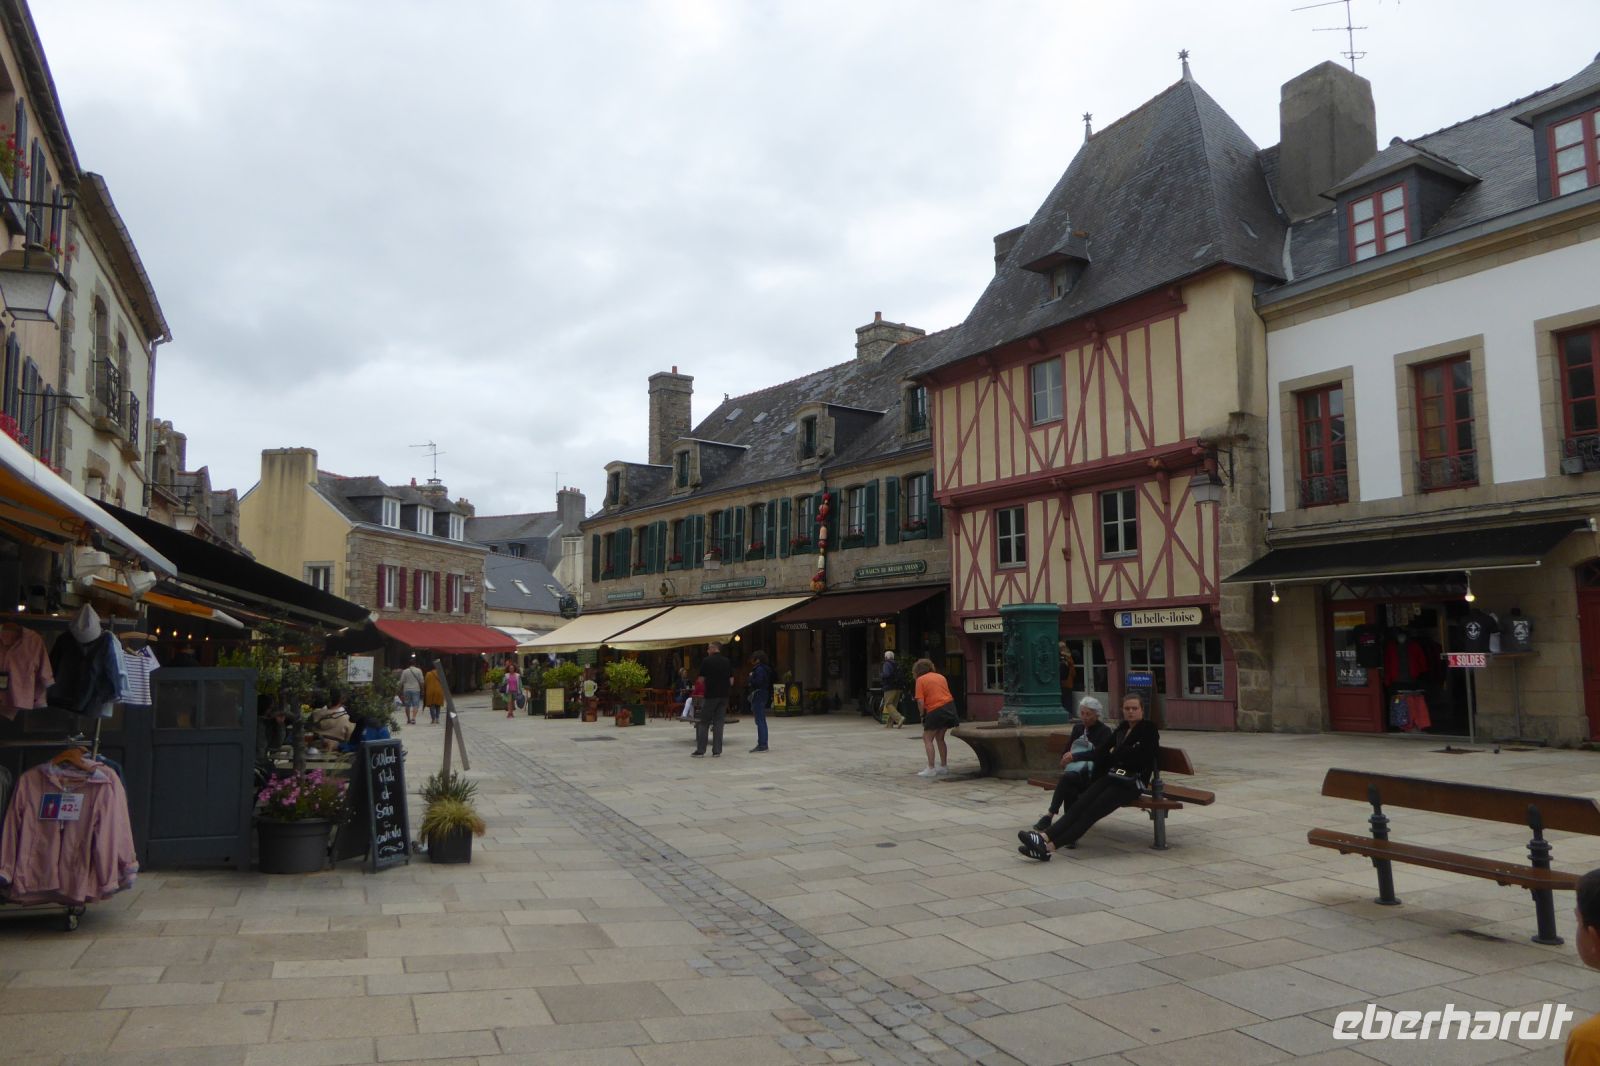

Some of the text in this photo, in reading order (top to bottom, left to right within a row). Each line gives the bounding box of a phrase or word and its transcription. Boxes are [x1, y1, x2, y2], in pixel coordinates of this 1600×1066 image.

[1134, 611, 1195, 624] la belle-iloise
[1456, 654, 1486, 666] SOLDES
